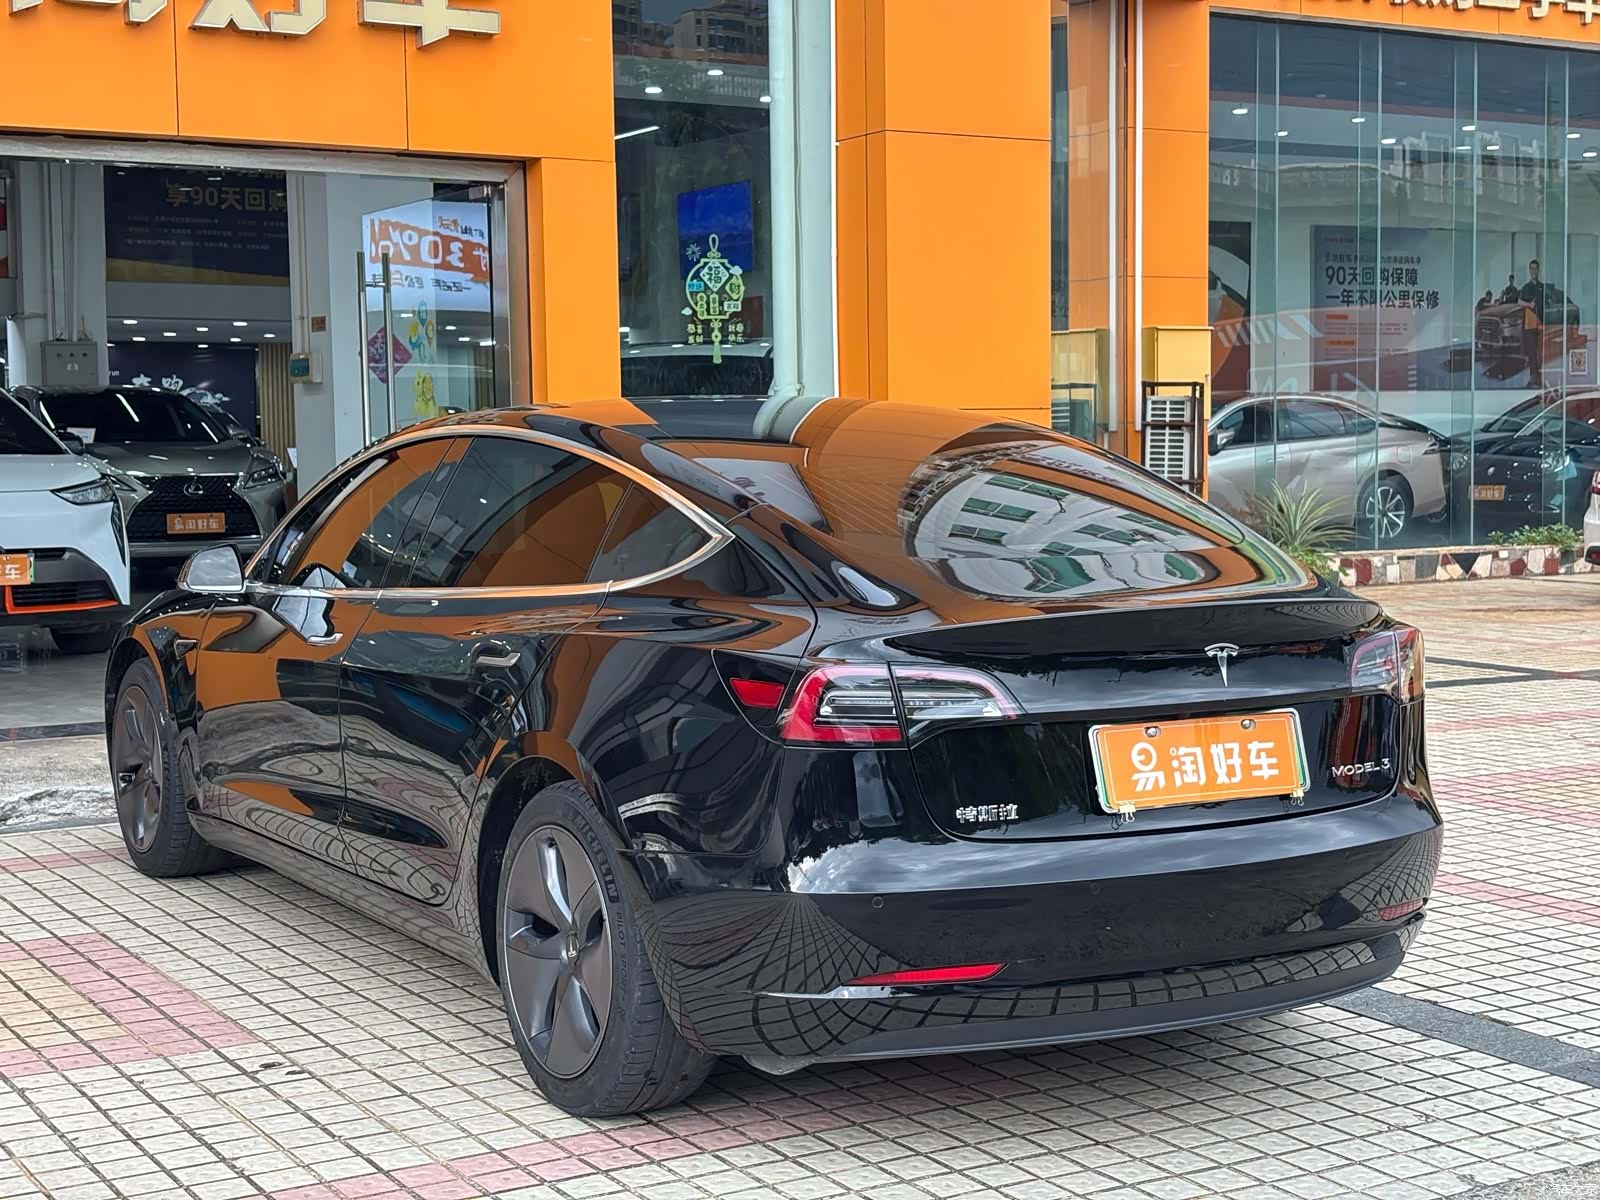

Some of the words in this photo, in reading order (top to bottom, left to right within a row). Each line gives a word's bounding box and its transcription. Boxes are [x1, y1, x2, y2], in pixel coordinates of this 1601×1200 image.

[704, 265, 723, 284] 福
[1325, 265, 1418, 287] 90天回购保障
[1325, 288, 1440, 309] 一年不限公里保修
[1131, 740, 1279, 792] 易淘好车
[1331, 761, 1380, 778] MODEL
[1381, 757, 1390, 769] 3
[956, 803, 1019, 823] 特斯拉
[573, 814, 618, 898] MICHELIN
[615, 911, 627, 949] PILOT
[619, 953, 628, 996] SPORT
